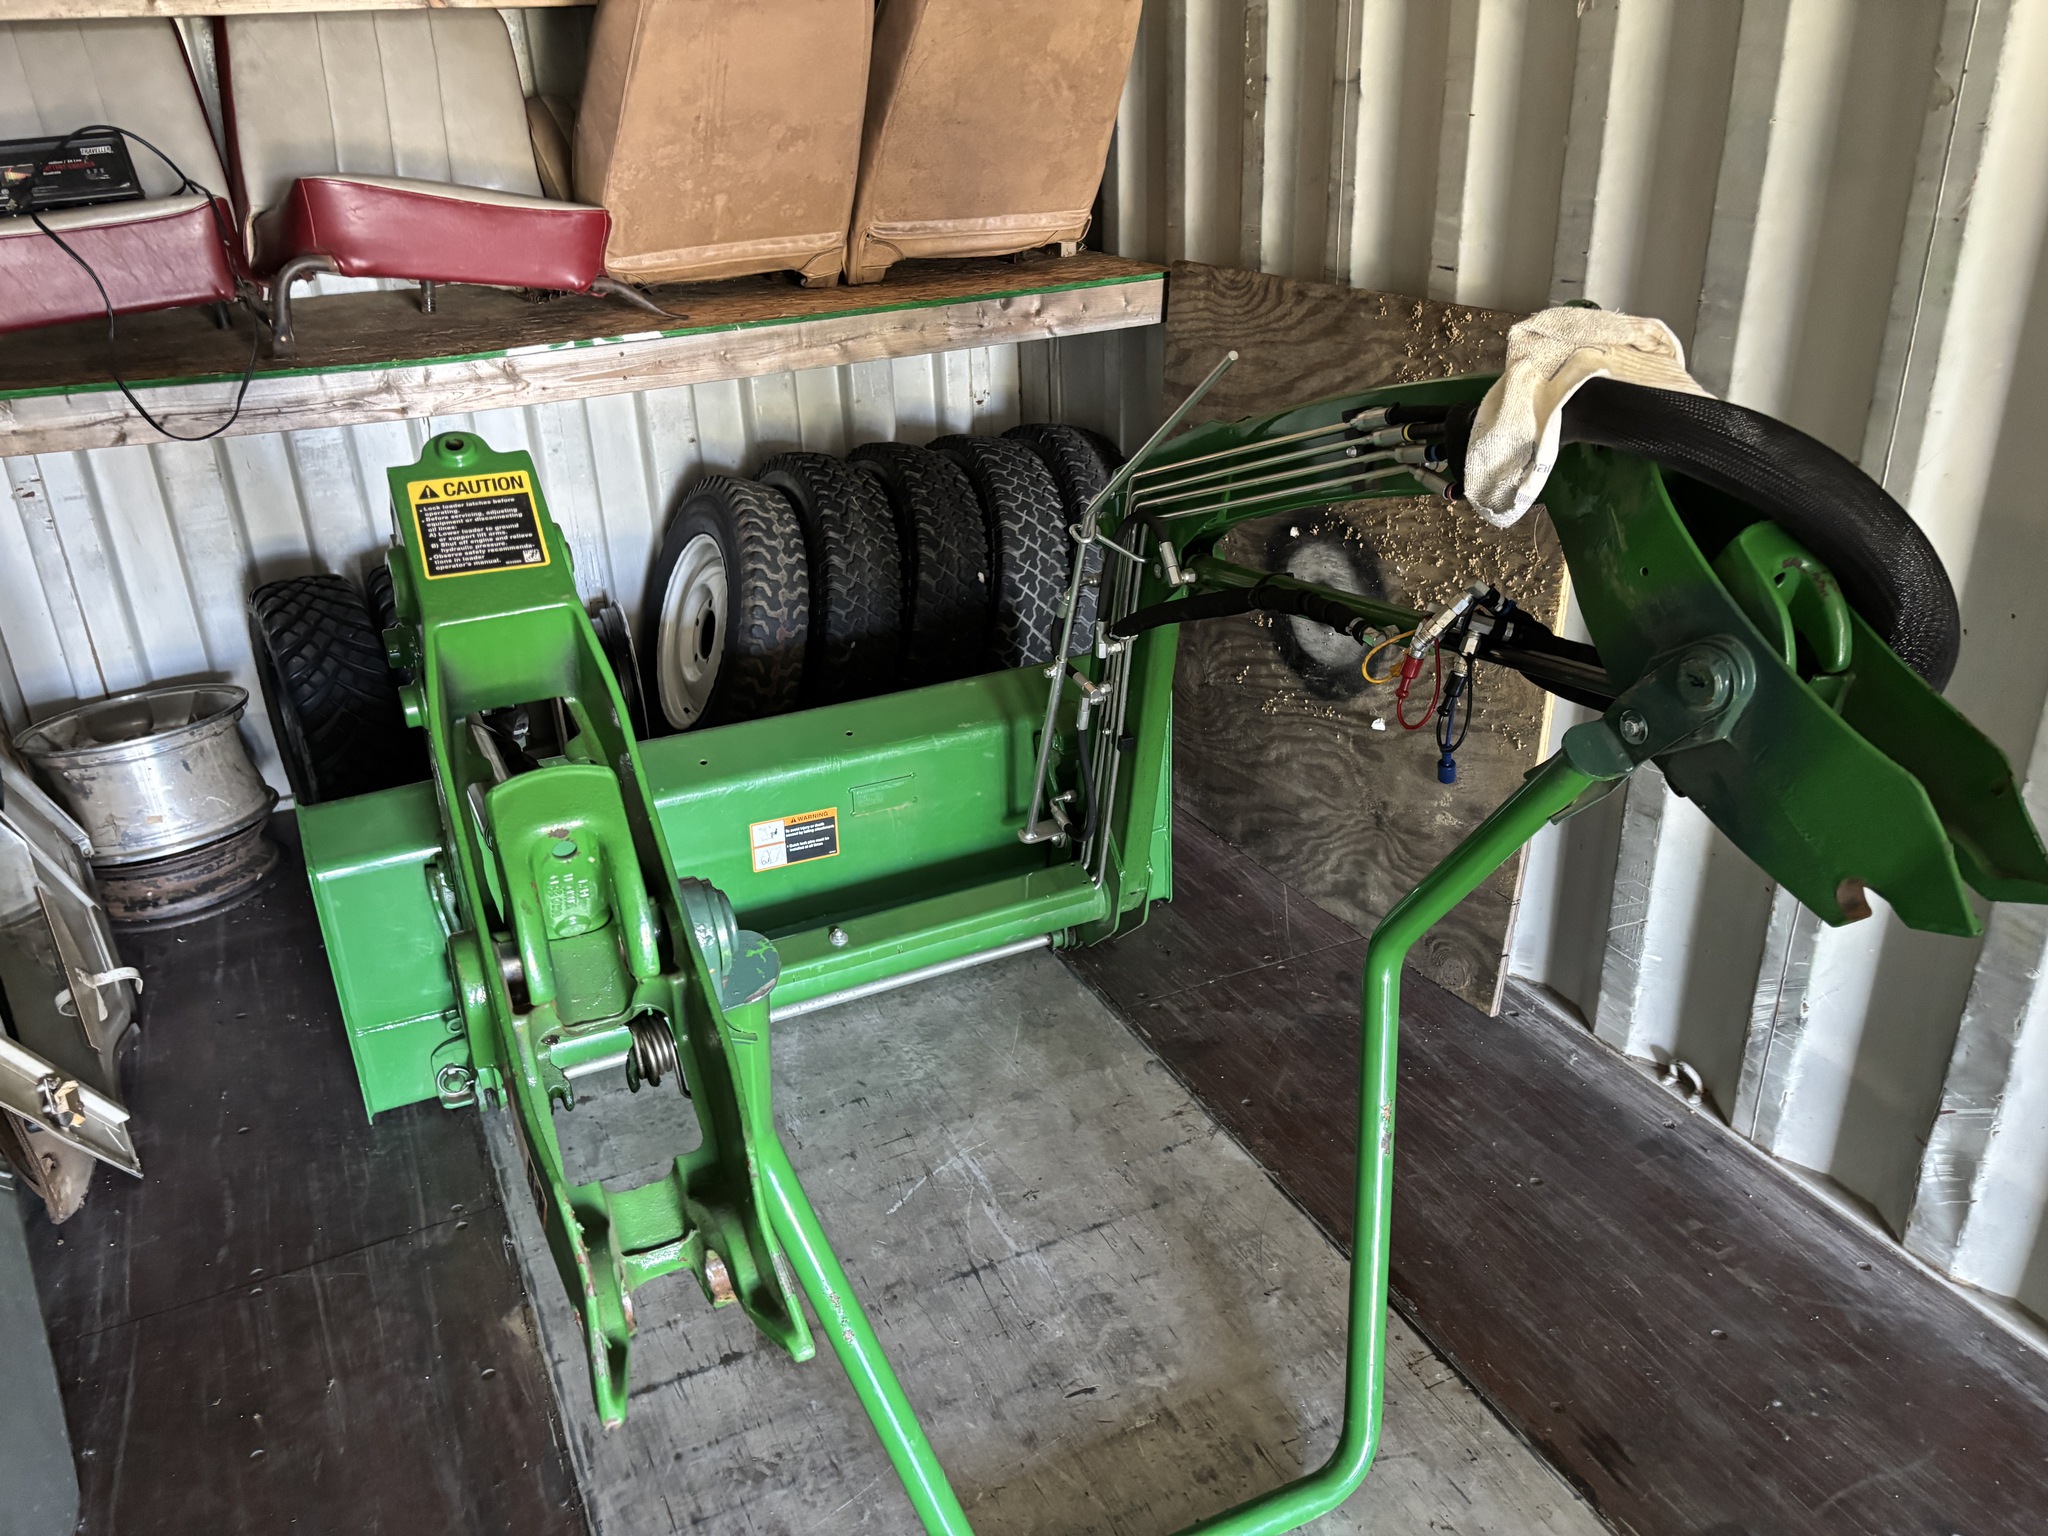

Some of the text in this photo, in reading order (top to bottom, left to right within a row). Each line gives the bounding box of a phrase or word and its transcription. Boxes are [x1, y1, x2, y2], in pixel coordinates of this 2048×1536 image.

[80, 146, 111, 155] TRAVELLER
[444, 475, 524, 496] CAUTION
[425, 509, 460, 517] operating.
[427, 519, 463, 527] equipment
[475, 513, 523, 522] disconnecting
[495, 523, 519, 531] ground
[488, 544, 535, 553] recommenda-
[436, 562, 472, 570] operator's
[474, 558, 501, 566] manual.
[798, 811, 828, 821] WARNING
